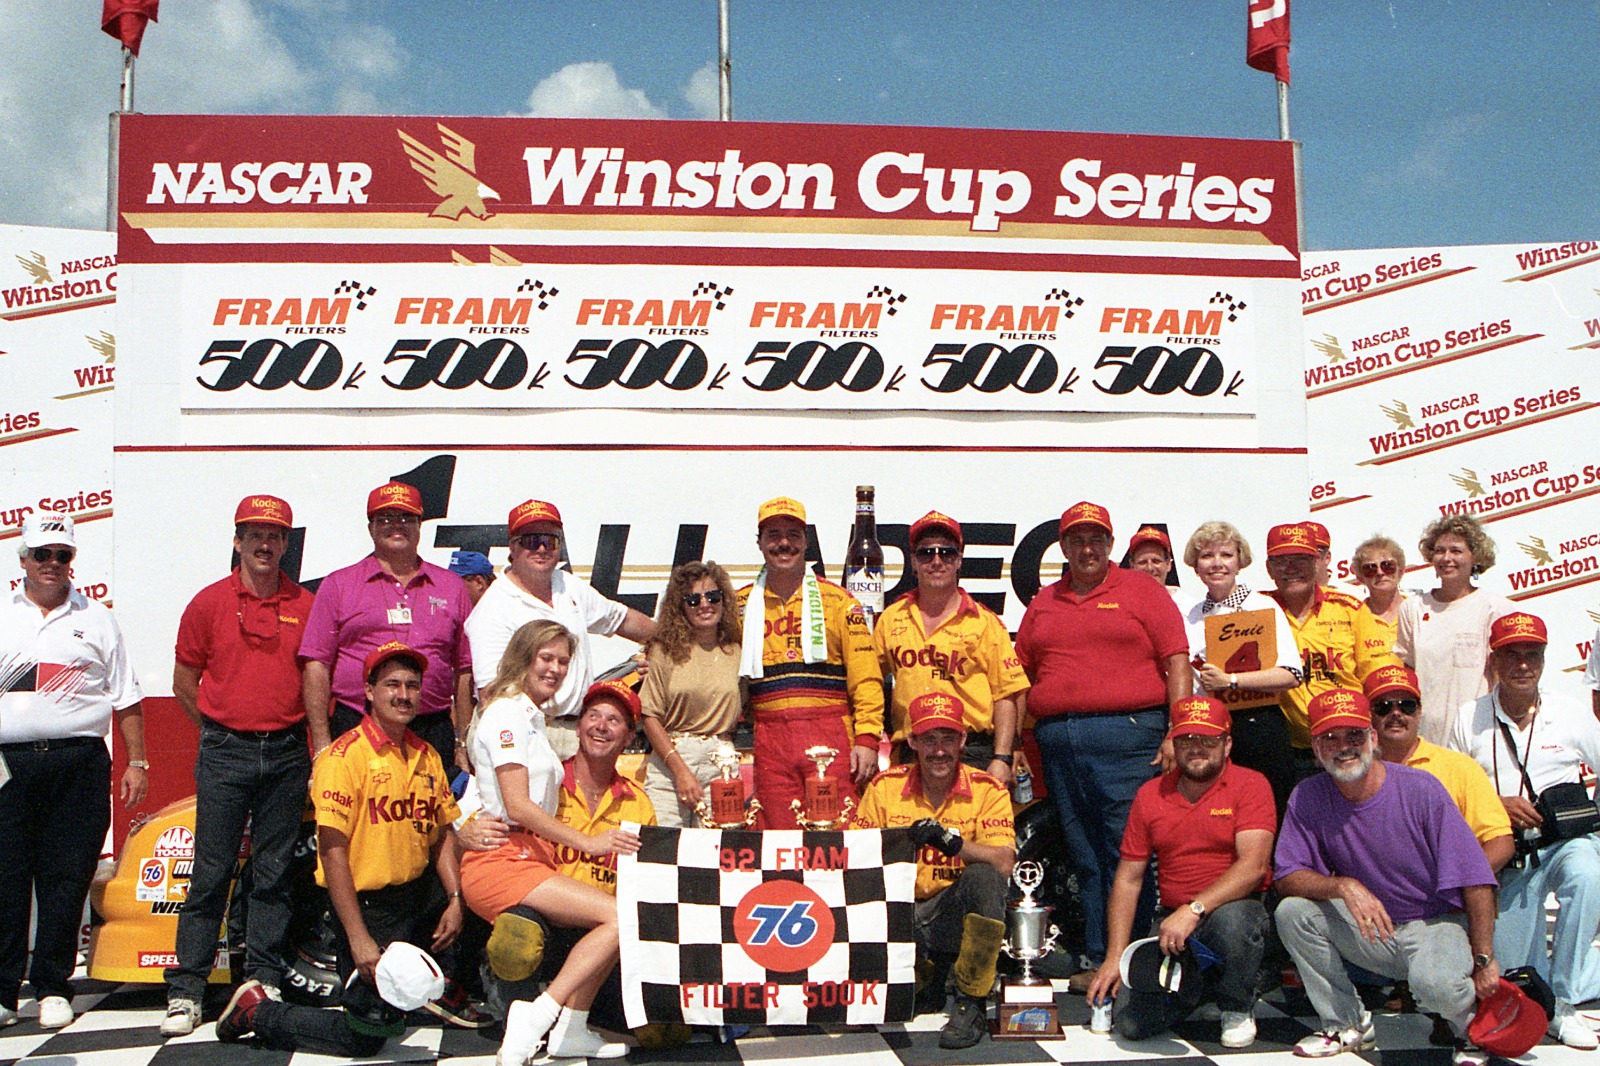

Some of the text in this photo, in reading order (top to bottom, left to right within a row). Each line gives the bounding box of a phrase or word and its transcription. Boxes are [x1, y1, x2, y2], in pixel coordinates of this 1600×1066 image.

[147, 161, 372, 205] NASCAR
[523, 147, 1275, 231] Winston Cup Series
[1516, 241, 1598, 271] Winsto
[1301, 261, 1341, 281] SCAR
[1325, 273, 1372, 296] Cup
[1375, 253, 1442, 283] Series
[2, 279, 103, 309] Winston
[213, 297, 353, 326] FRAM
[393, 297, 531, 325] FRAM
[575, 298, 711, 326] FRAM
[749, 301, 882, 329] FRAM
[929, 304, 1060, 332] FRAM
[1099, 307, 1223, 336] FRAM
[469, 326, 530, 334] FILTERS
[648, 327, 709, 335] FILTERS
[820, 330, 878, 338] FILTERS
[999, 332, 1057, 340] FILTERS
[1165, 336, 1221, 345] FILTERS
[1352, 326, 1410, 351] NASCAR
[1304, 319, 1512, 387] Winston Cup Series
[1421, 393, 1479, 418] NASCAR
[1369, 385, 1581, 455] Winston Cup Series
[1490, 461, 1548, 486] NASCAR
[1533, 473, 1580, 498] Cup
[379, 485, 410, 496] Kodak
[0, 489, 113, 527] up Series
[252, 498, 282, 510] Kodak
[1279, 526, 1308, 536] Kodak
[1559, 534, 1600, 555] NASC
[1508, 555, 1599, 591] Winston
[847, 581, 882, 593] BUSCH
[279, 615, 299, 624] Kodak
[1218, 623, 1264, 641] Ernie
[1502, 614, 1535, 626] Kodak
[890, 644, 968, 677] Kodak
[1224, 641, 1261, 674] 4
[1376, 669, 1409, 680] Kodak
[920, 695, 953, 708] Kodak
[1178, 699, 1211, 712] Kodak
[1319, 692, 1355, 707] Kodak
[322, 789, 353, 809] odak
[368, 792, 442, 825] Kodak
[1210, 807, 1233, 816] Kodak
[981, 817, 1014, 830] Koda
[155, 849, 193, 857] TOOLS
[776, 845, 849, 872] FRAM
[144, 866, 161, 881] 76
[747, 901, 818, 947] 76
[682, 981, 779, 1010] FILTER
